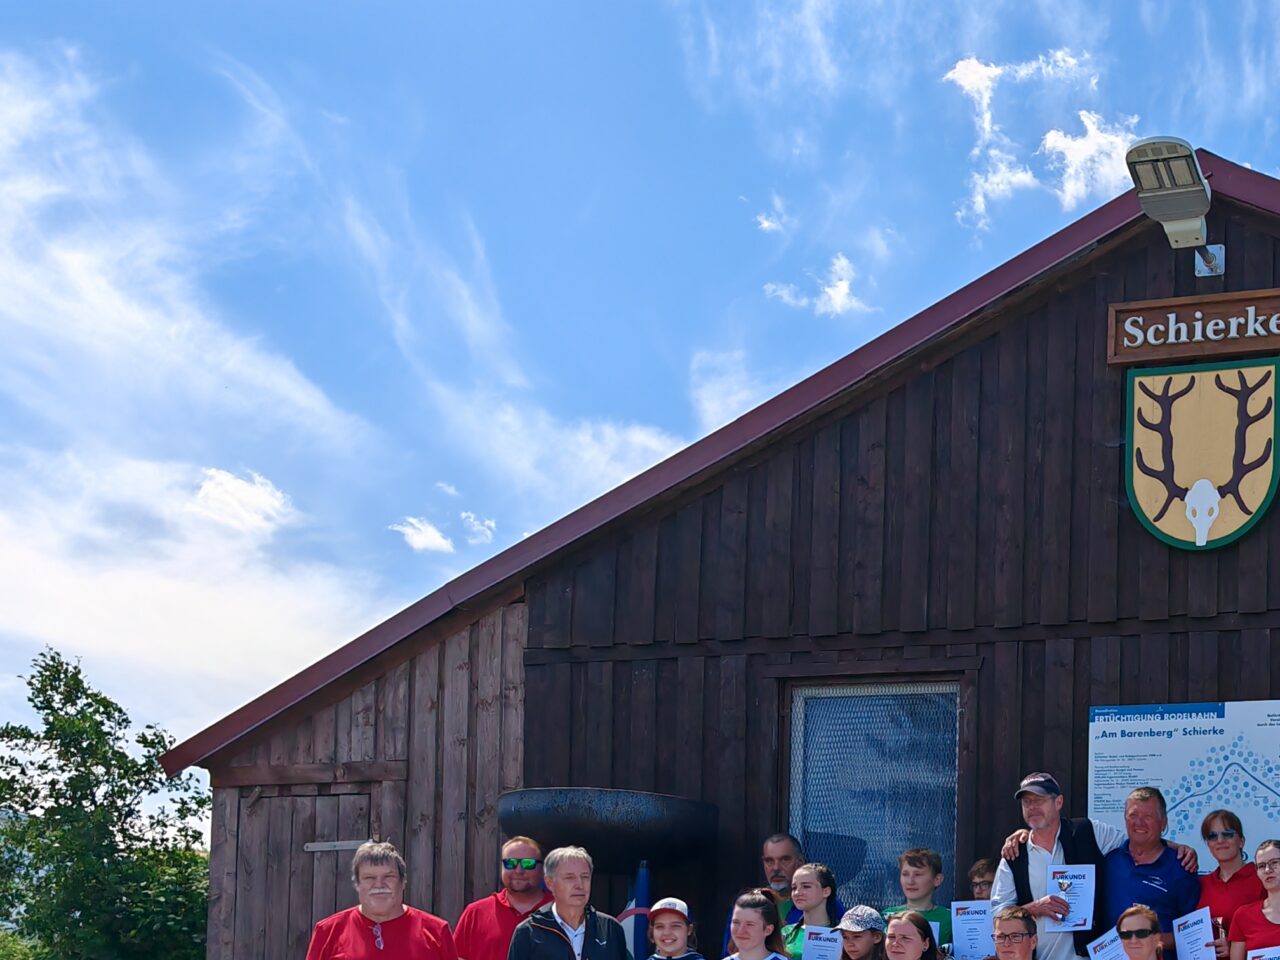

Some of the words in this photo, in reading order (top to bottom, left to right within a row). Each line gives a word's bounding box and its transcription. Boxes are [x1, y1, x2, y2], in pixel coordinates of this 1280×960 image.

[1094, 712, 1161, 723] ERTÜCHTIGUNG
[1163, 711, 1218, 721] RODELBAHN
[1182, 726, 1225, 737] Schierke
[1096, 935, 1119, 953] URKUND
